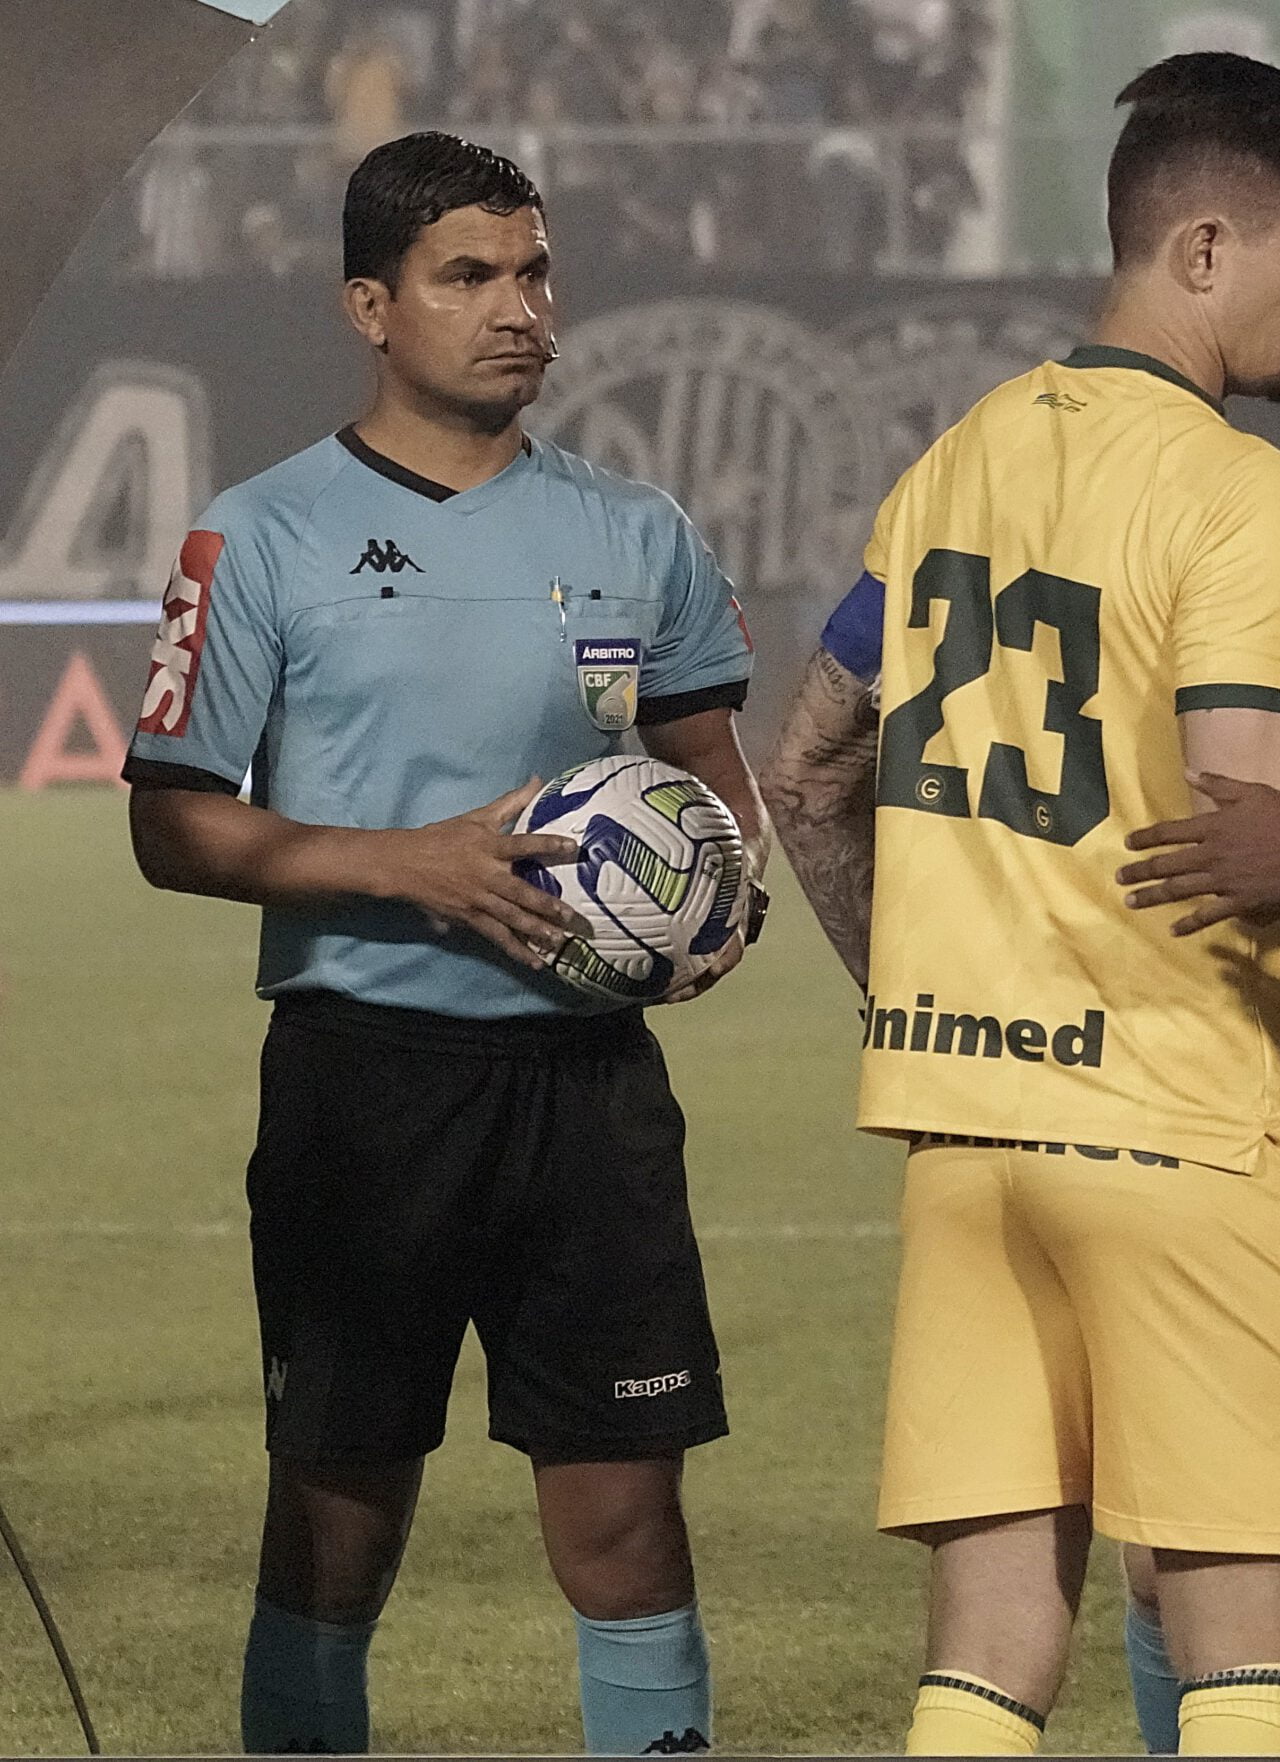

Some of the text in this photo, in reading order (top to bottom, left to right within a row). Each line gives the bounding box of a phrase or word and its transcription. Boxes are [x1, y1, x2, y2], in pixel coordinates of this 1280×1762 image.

[140, 553, 202, 732] SKY
[582, 646, 635, 659] ÁRBITRO
[585, 673, 612, 688] CBF
[875, 547, 1111, 848] 23
[615, 1369, 691, 1399] Kappa
